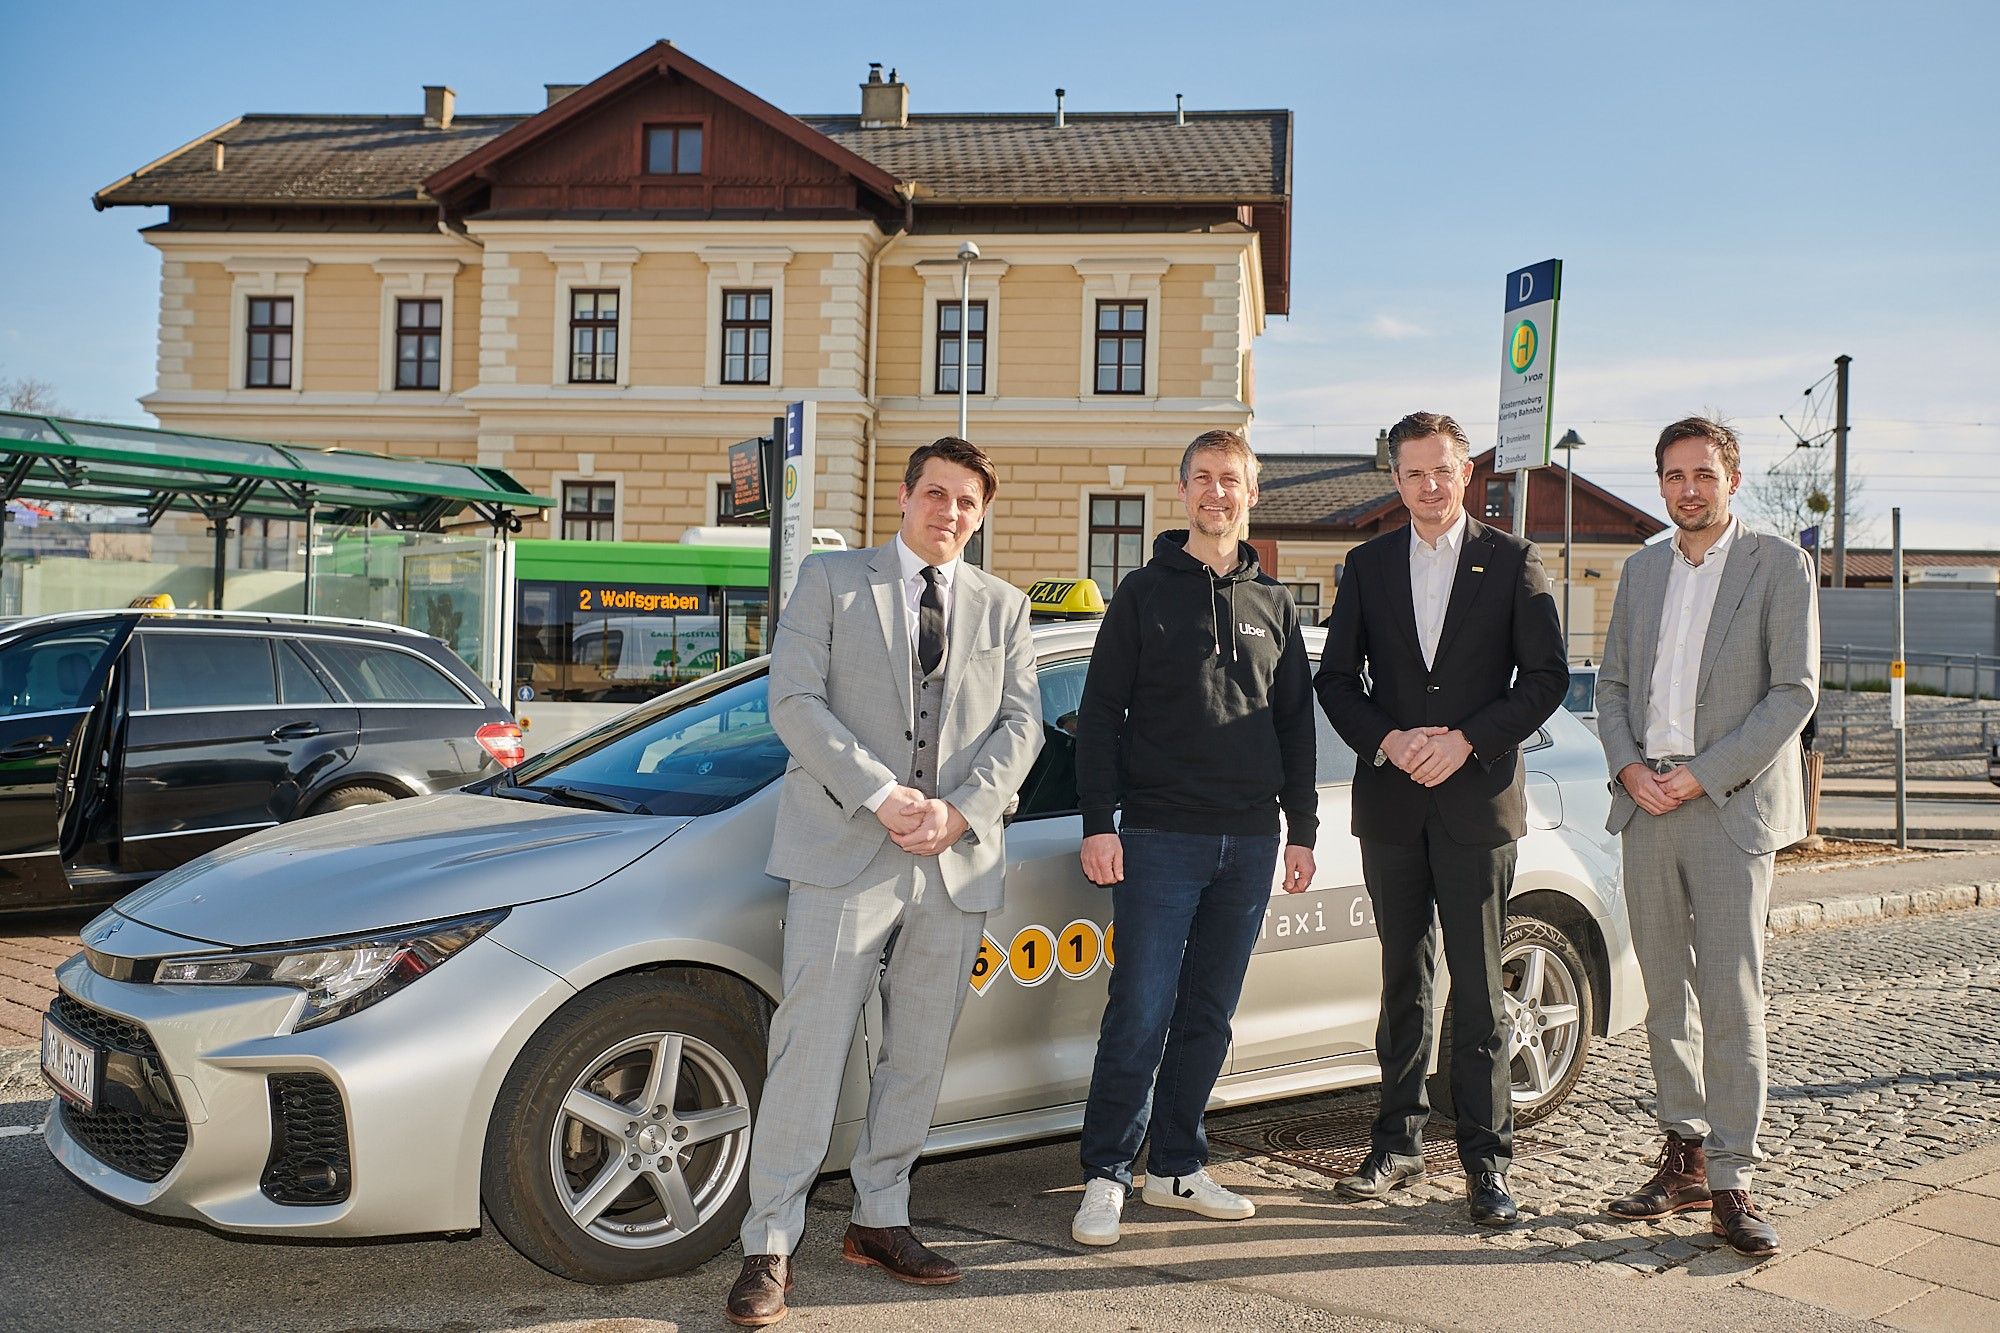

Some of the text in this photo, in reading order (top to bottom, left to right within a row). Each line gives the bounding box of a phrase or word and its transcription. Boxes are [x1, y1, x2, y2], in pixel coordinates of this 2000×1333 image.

[1519, 272, 1533, 302] D
[1517, 330, 1530, 363] H
[1528, 373, 1544, 382] VOR
[1499, 405, 1543, 421] Kierling Bahnhof
[1501, 396, 1542, 411] Klosterneuburg
[787, 411, 796, 452] E
[1498, 453, 1526, 468] 3 Strandbad
[580, 589, 699, 611] 2 Wolfsgraben
[1029, 583, 1073, 602] TAXI
[1238, 622, 1265, 638] Uber
[1261, 901, 1327, 939] Taxi
